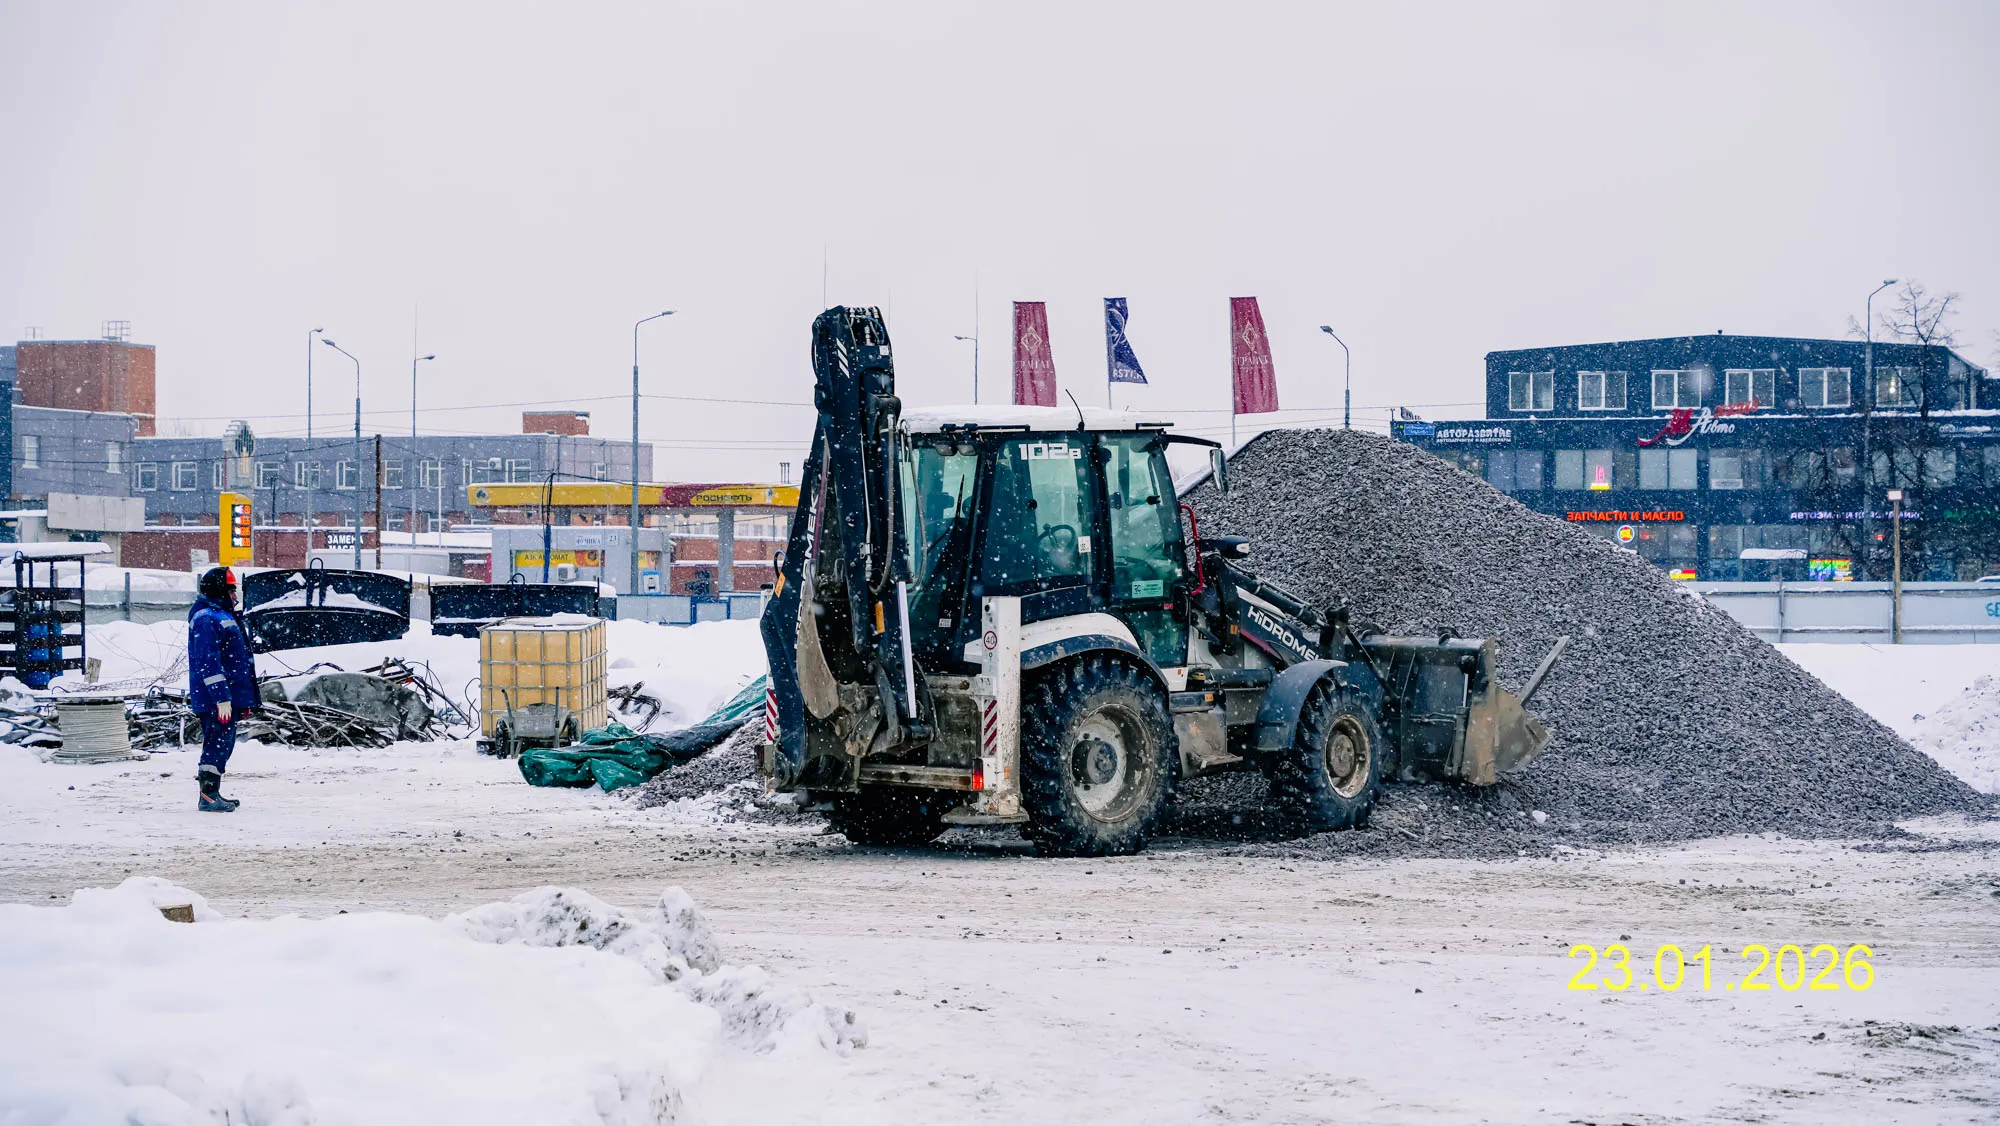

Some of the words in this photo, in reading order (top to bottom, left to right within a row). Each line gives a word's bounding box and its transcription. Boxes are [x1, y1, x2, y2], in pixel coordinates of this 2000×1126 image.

[1566, 511, 1627, 521] ЗАПЧАСТИ
[1631, 511, 1640, 521] И
[1643, 511, 1684, 521] МАСЛО
[985, 635, 995, 645] 40
